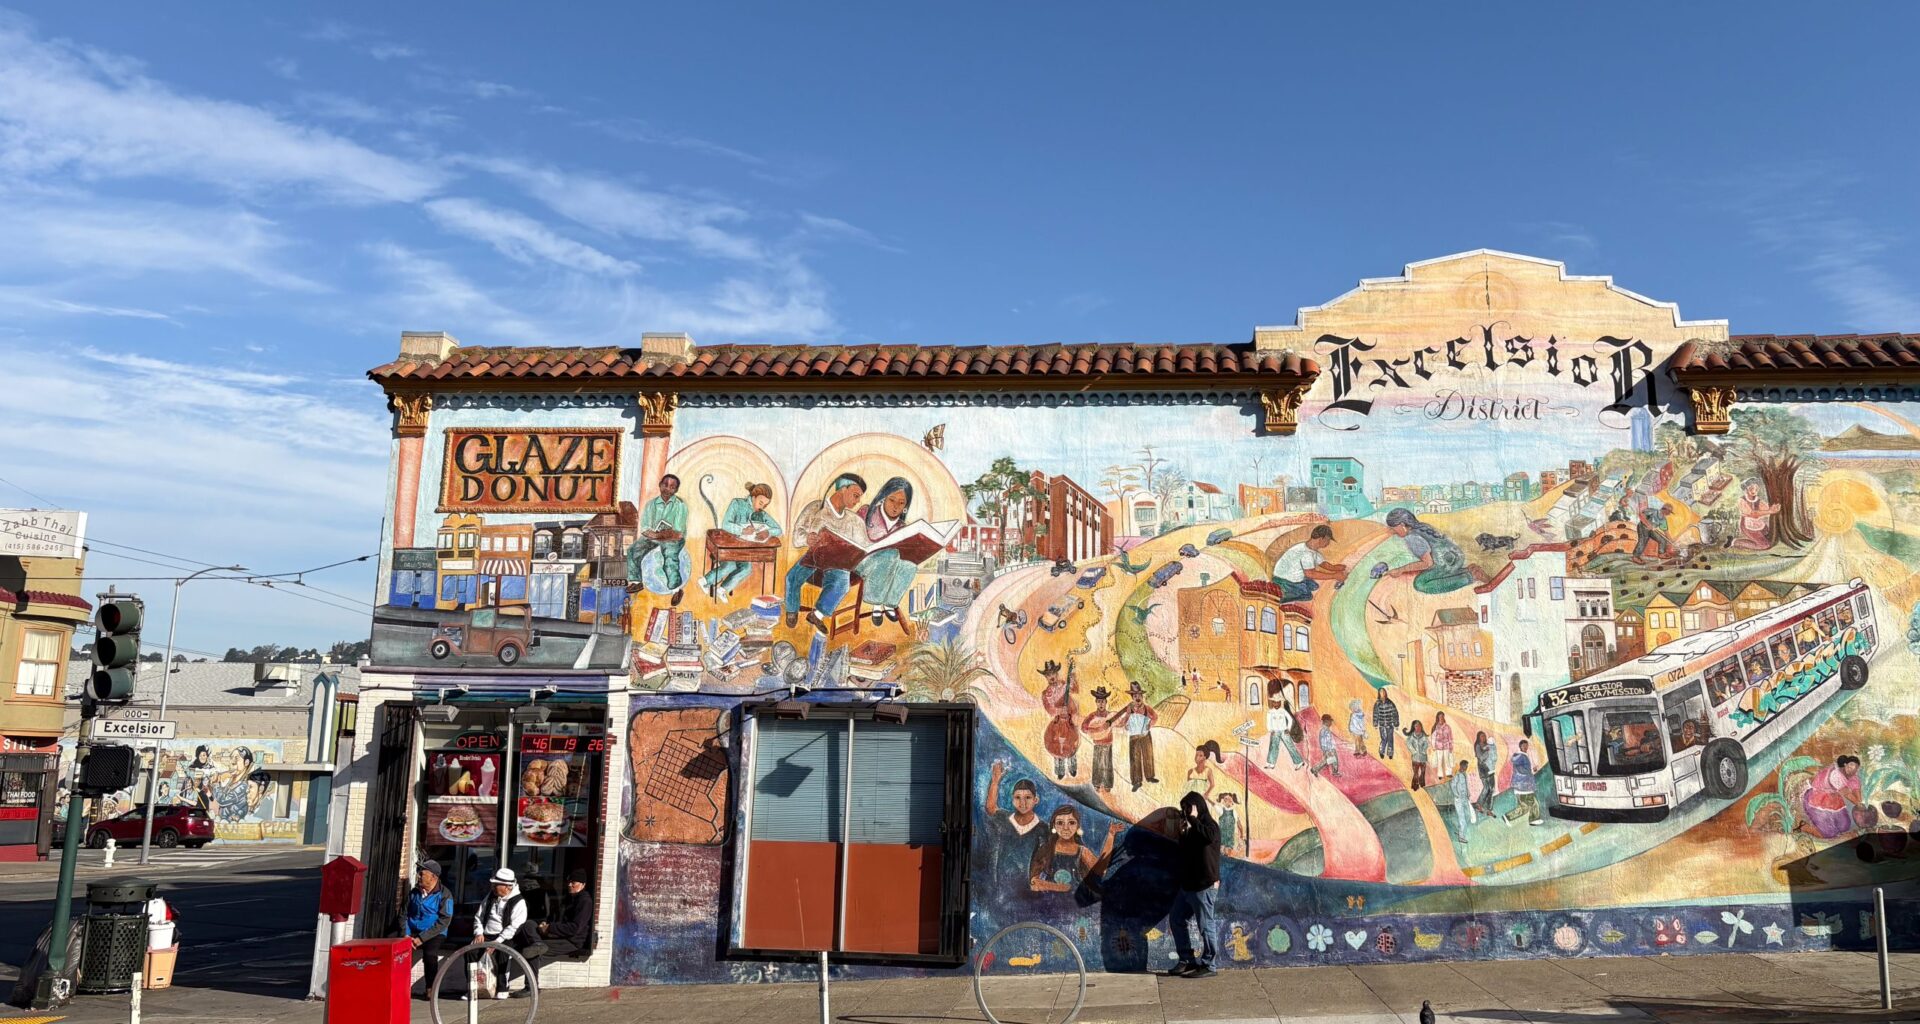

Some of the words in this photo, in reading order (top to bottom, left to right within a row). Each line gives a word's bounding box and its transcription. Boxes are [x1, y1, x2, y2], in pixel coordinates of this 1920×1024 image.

[1423, 388, 1550, 421] District
[454, 434, 614, 475] GLAZE
[459, 475, 604, 502] DONUT
[3, 516, 38, 532] Zabb
[43, 517, 73, 535] Thai
[15, 531, 57, 541] Cuisine
[1667, 666, 1687, 683] 0721
[1580, 682, 1623, 693] EXCELSIOR
[1548, 689, 1569, 707] 52
[1569, 687, 1645, 703] GENEVA/MISSION
[124, 710, 142, 718] 000
[104, 721, 165, 734] Excelsior
[456, 735, 500, 749] OPEN
[532, 738, 549, 750] 46
[564, 738, 577, 750] 19
[587, 739, 604, 751] 26
